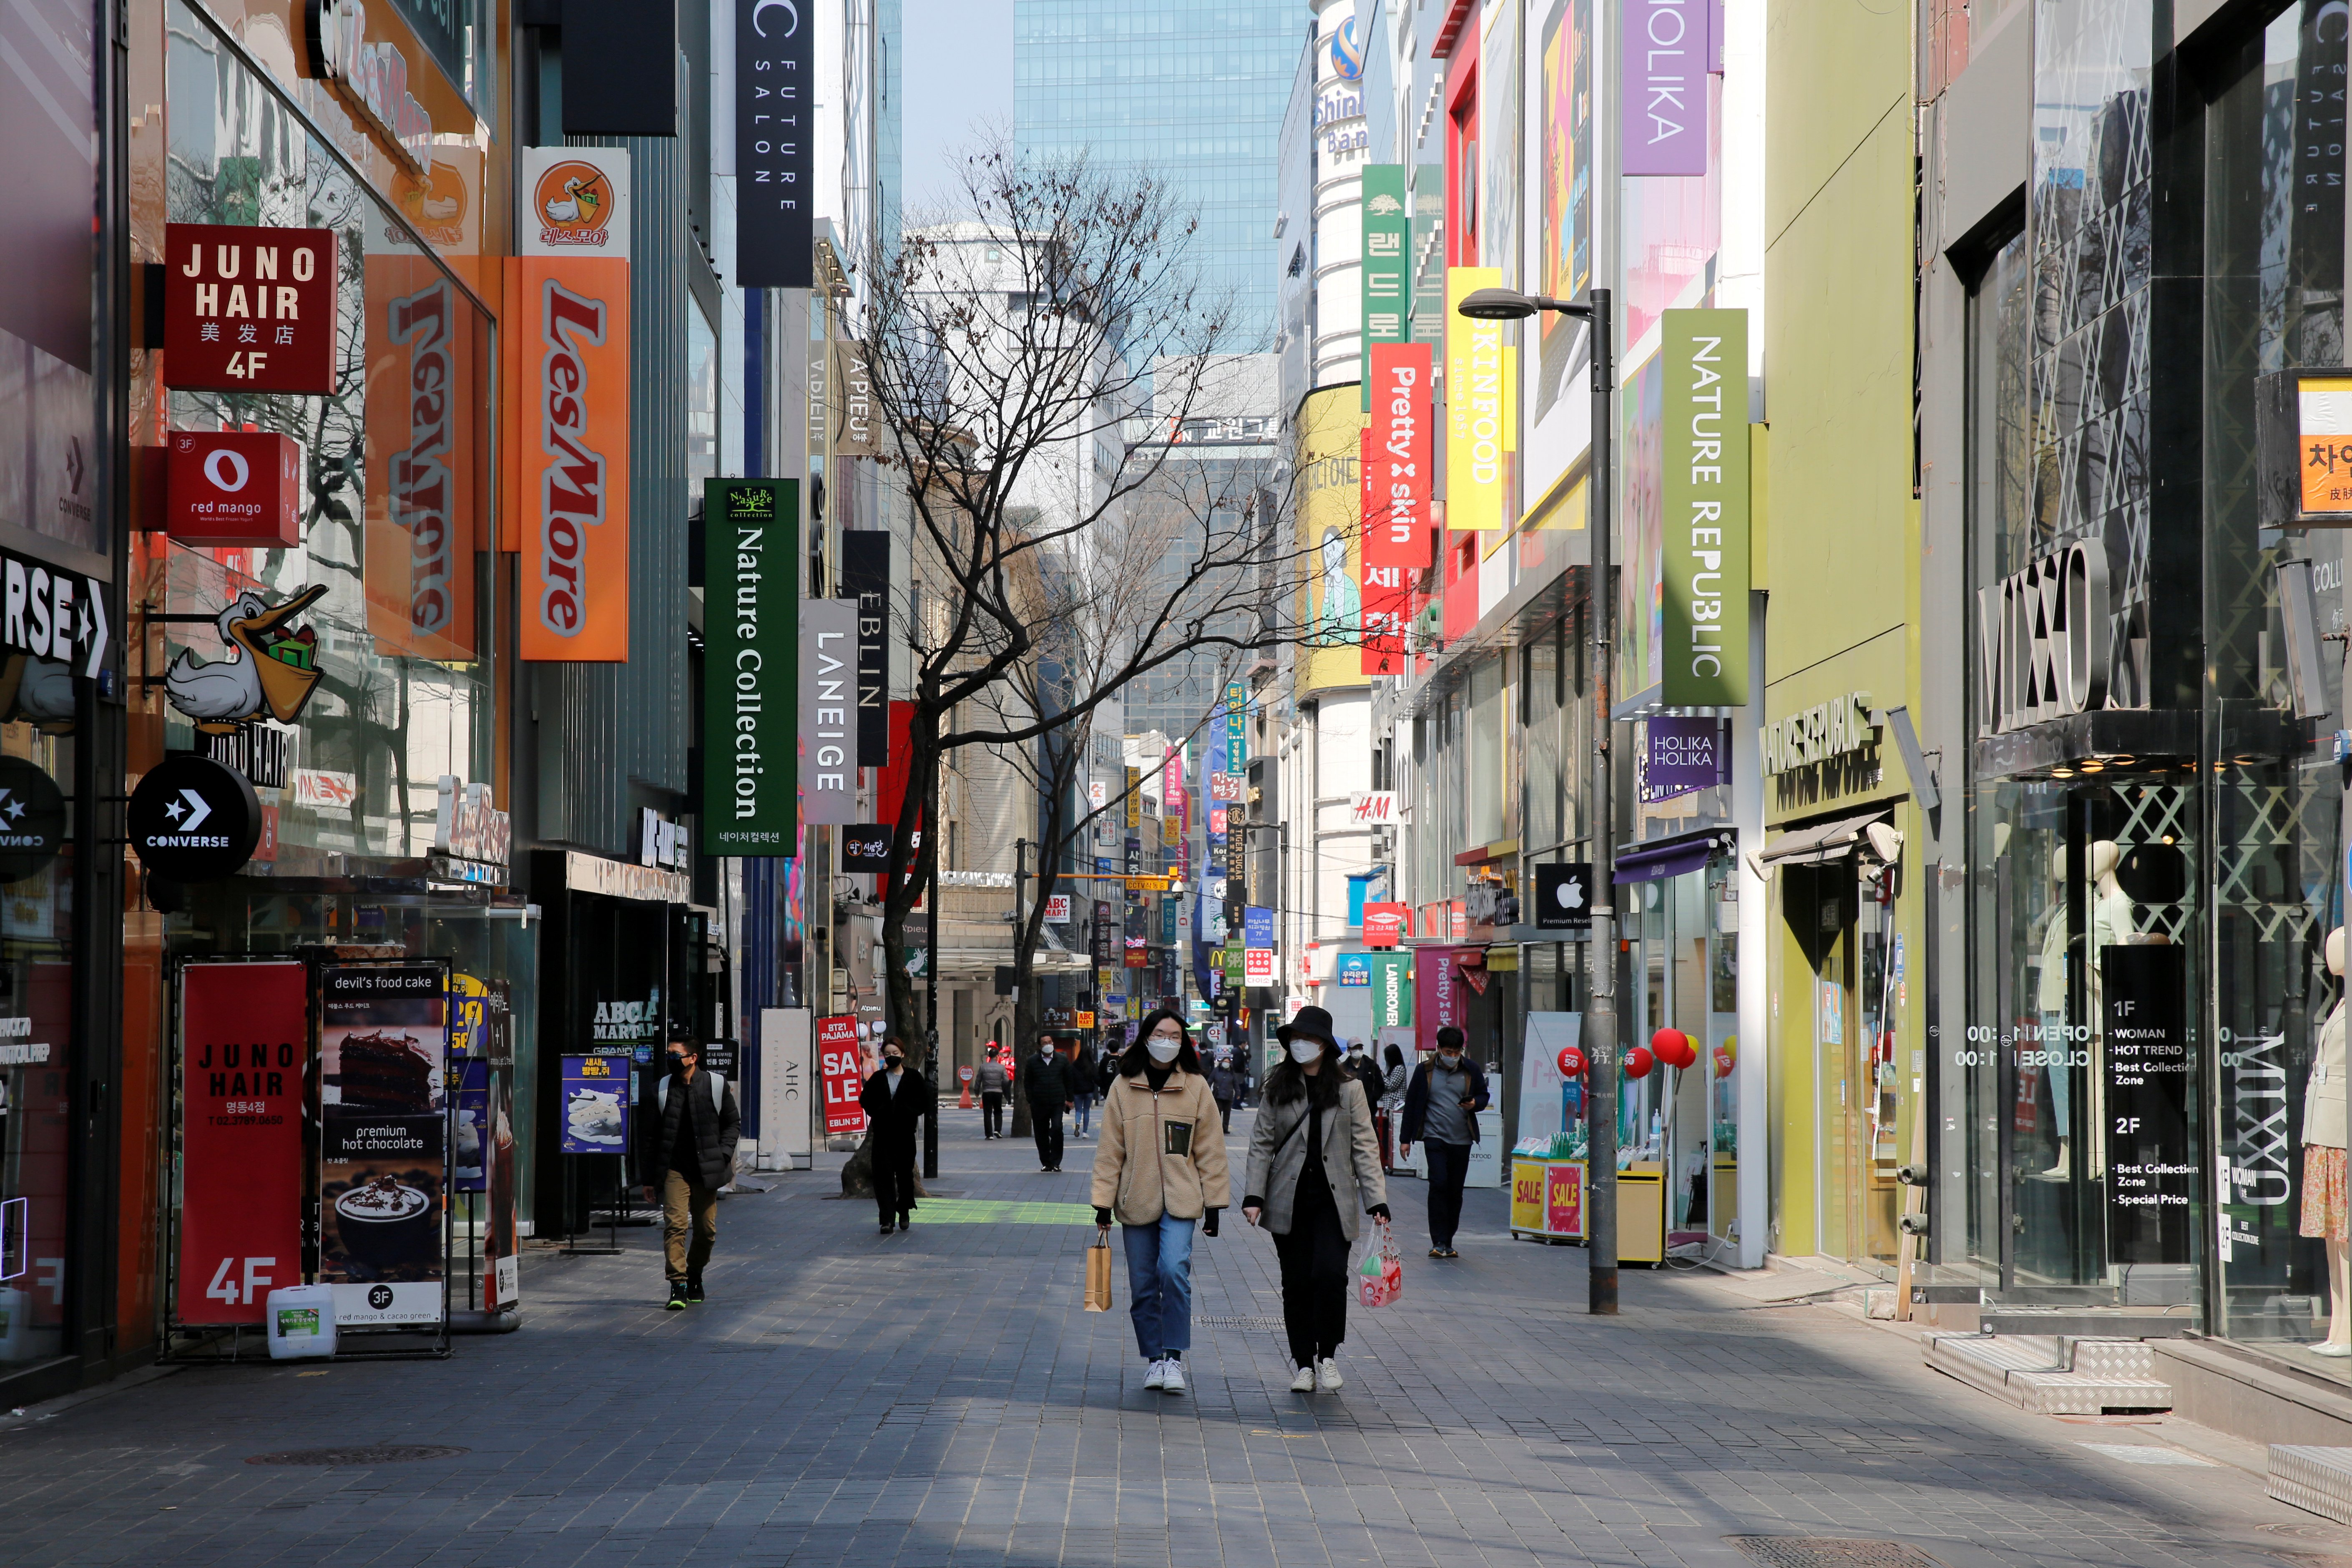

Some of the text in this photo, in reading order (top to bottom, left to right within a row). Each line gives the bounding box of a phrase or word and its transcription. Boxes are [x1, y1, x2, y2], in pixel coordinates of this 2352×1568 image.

[1648, 0, 1685, 145] OLIKA
[755, 60, 770, 182] SALON
[781, 60, 796, 209] FUTURE
[540, 227, 608, 246] 레스모아
[183, 244, 315, 281] JUNO
[1369, 232, 1399, 337] 랜드로
[196, 283, 299, 320] HAIR
[201, 322, 294, 345] 美发店
[226, 351, 267, 379] 4F
[1455, 357, 1464, 402] since
[1472, 318, 1497, 484] SKINFOOD
[180, 439, 192, 448] 3F
[546, 284, 601, 631] LesMore
[1387, 367, 1417, 543] Pretty skin
[191, 501, 261, 516] red mango
[1692, 337, 1722, 678] NATURE REPUBLIC
[2313, 558, 2343, 593] COLL
[5, 558, 73, 662] RSE
[859, 592, 882, 708] EBLIN
[736, 527, 764, 820] Nature Collection
[817, 631, 845, 792] LANEIGE
[1654, 736, 1713, 750] HOLIKA
[253, 722, 289, 788] HAIR
[1654, 751, 1713, 766] HOLIKA
[1355, 796, 1391, 820] H&M
[146, 836, 229, 848] CONVERSE
[719, 832, 780, 843] 네이처컬렉션
[1235, 829, 1243, 881] TIGER SUGAR
[1046, 898, 1067, 908] ABC
[1134, 939, 1146, 947] 2F
[335, 976, 432, 989] devil's food cake
[1437, 958, 1452, 1025] Pretty sk
[1386, 963, 1398, 1027] LANDROVER
[593, 1002, 640, 1023] ABC
[2114, 1001, 2135, 1017] 1F
[593, 1025, 640, 1039] MART
[821, 1030, 855, 1041] PAJAMA
[828, 1023, 847, 1032] BT21
[2115, 1029, 2165, 1039] WOMAN
[198, 1043, 293, 1069] JUNO
[1591, 1047, 1609, 1065] 중구
[2115, 1045, 2183, 1055] HOT TREND
[2115, 1062, 2196, 1073] Best Collection
[209, 1072, 283, 1097] HAIR
[785, 1060, 799, 1101] AHC
[2115, 1076, 2144, 1086] Zone
[226, 1101, 265, 1114] 명동4점
[356, 1125, 407, 1140] premium
[829, 1117, 861, 1127] EBLIN 3F
[2116, 1118, 2140, 1133] 2F
[342, 1138, 423, 1150] hot chocolate
[2117, 1163, 2199, 1174] Best Collection
[2231, 1166, 2257, 1188] WOMAN
[1516, 1179, 1541, 1205] SALE
[2118, 1178, 2146, 1187] Zone
[1552, 1183, 1578, 1208] SALE
[2118, 1195, 2189, 1205] Special Price
[206, 1257, 276, 1305] 4F
[373, 1291, 389, 1304] 3F
